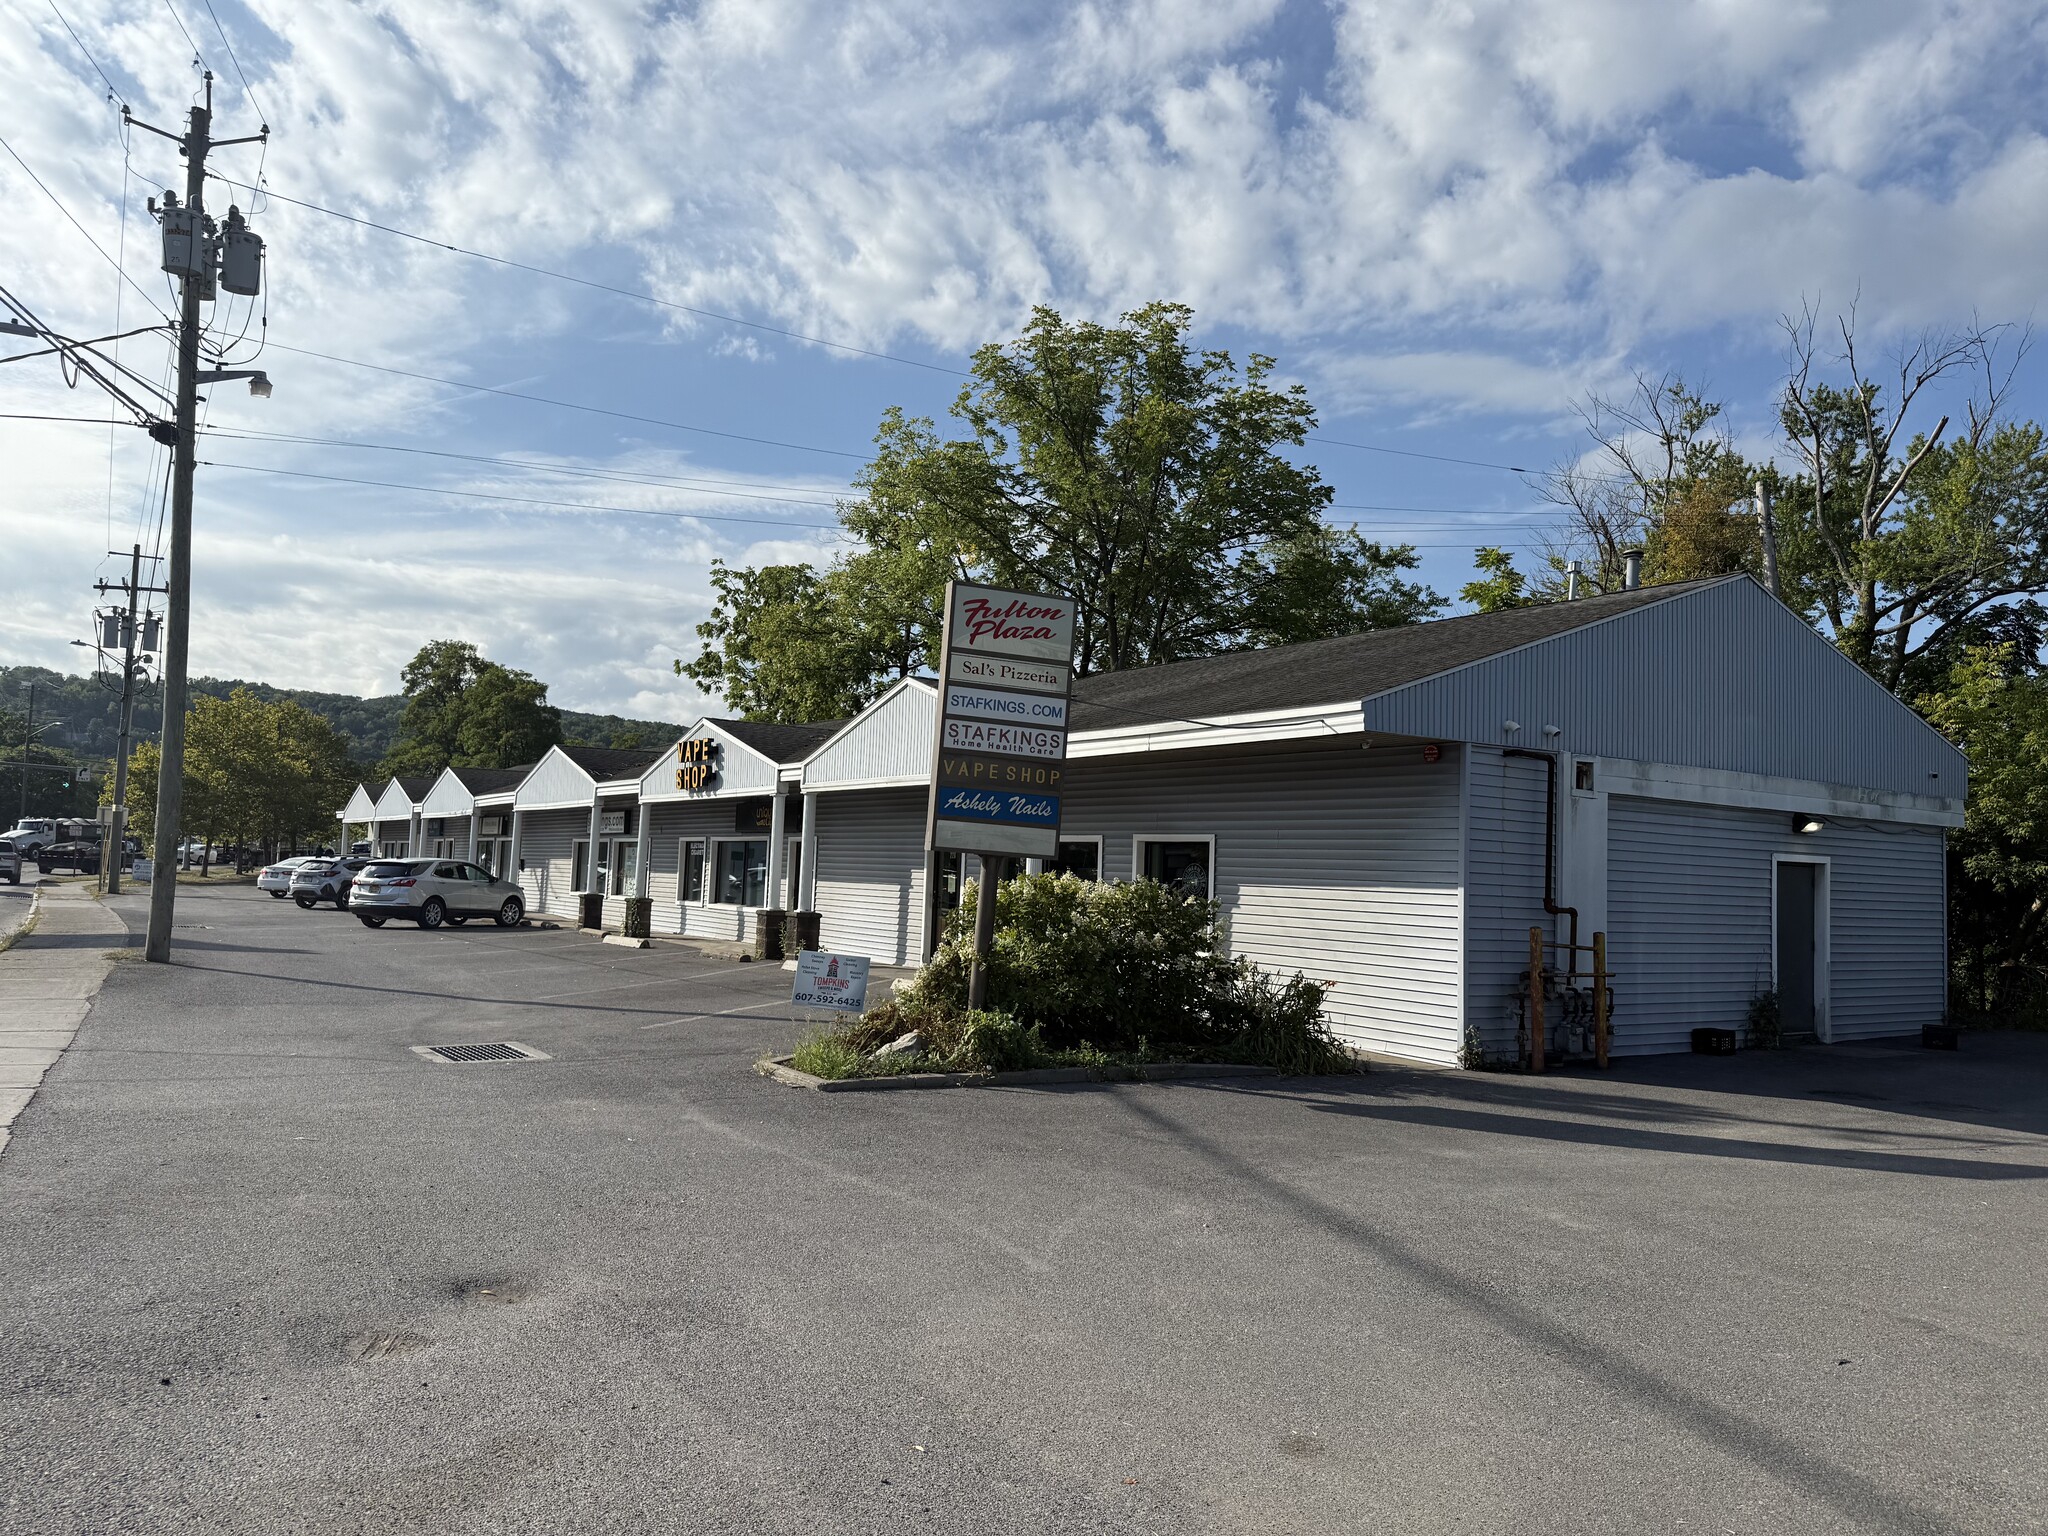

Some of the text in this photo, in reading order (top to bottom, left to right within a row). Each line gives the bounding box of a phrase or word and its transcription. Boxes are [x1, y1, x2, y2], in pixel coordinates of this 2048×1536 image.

[963, 598, 1066, 627] Fulton
[969, 619, 1058, 647] Plaza
[962, 660, 1058, 685] Sal's Pizzeria
[947, 723, 1061, 749] STAFKINGS
[952, 738, 1054, 756] Home Health Care
[677, 738, 709, 763] VAPE
[676, 764, 707, 791] SHOP
[943, 759, 1061, 786] VAPE SHOP
[944, 791, 1053, 818] Ashely Nails
[813, 976, 850, 990] TOMPKINS
[795, 992, 861, 1007] 607-592-6425
